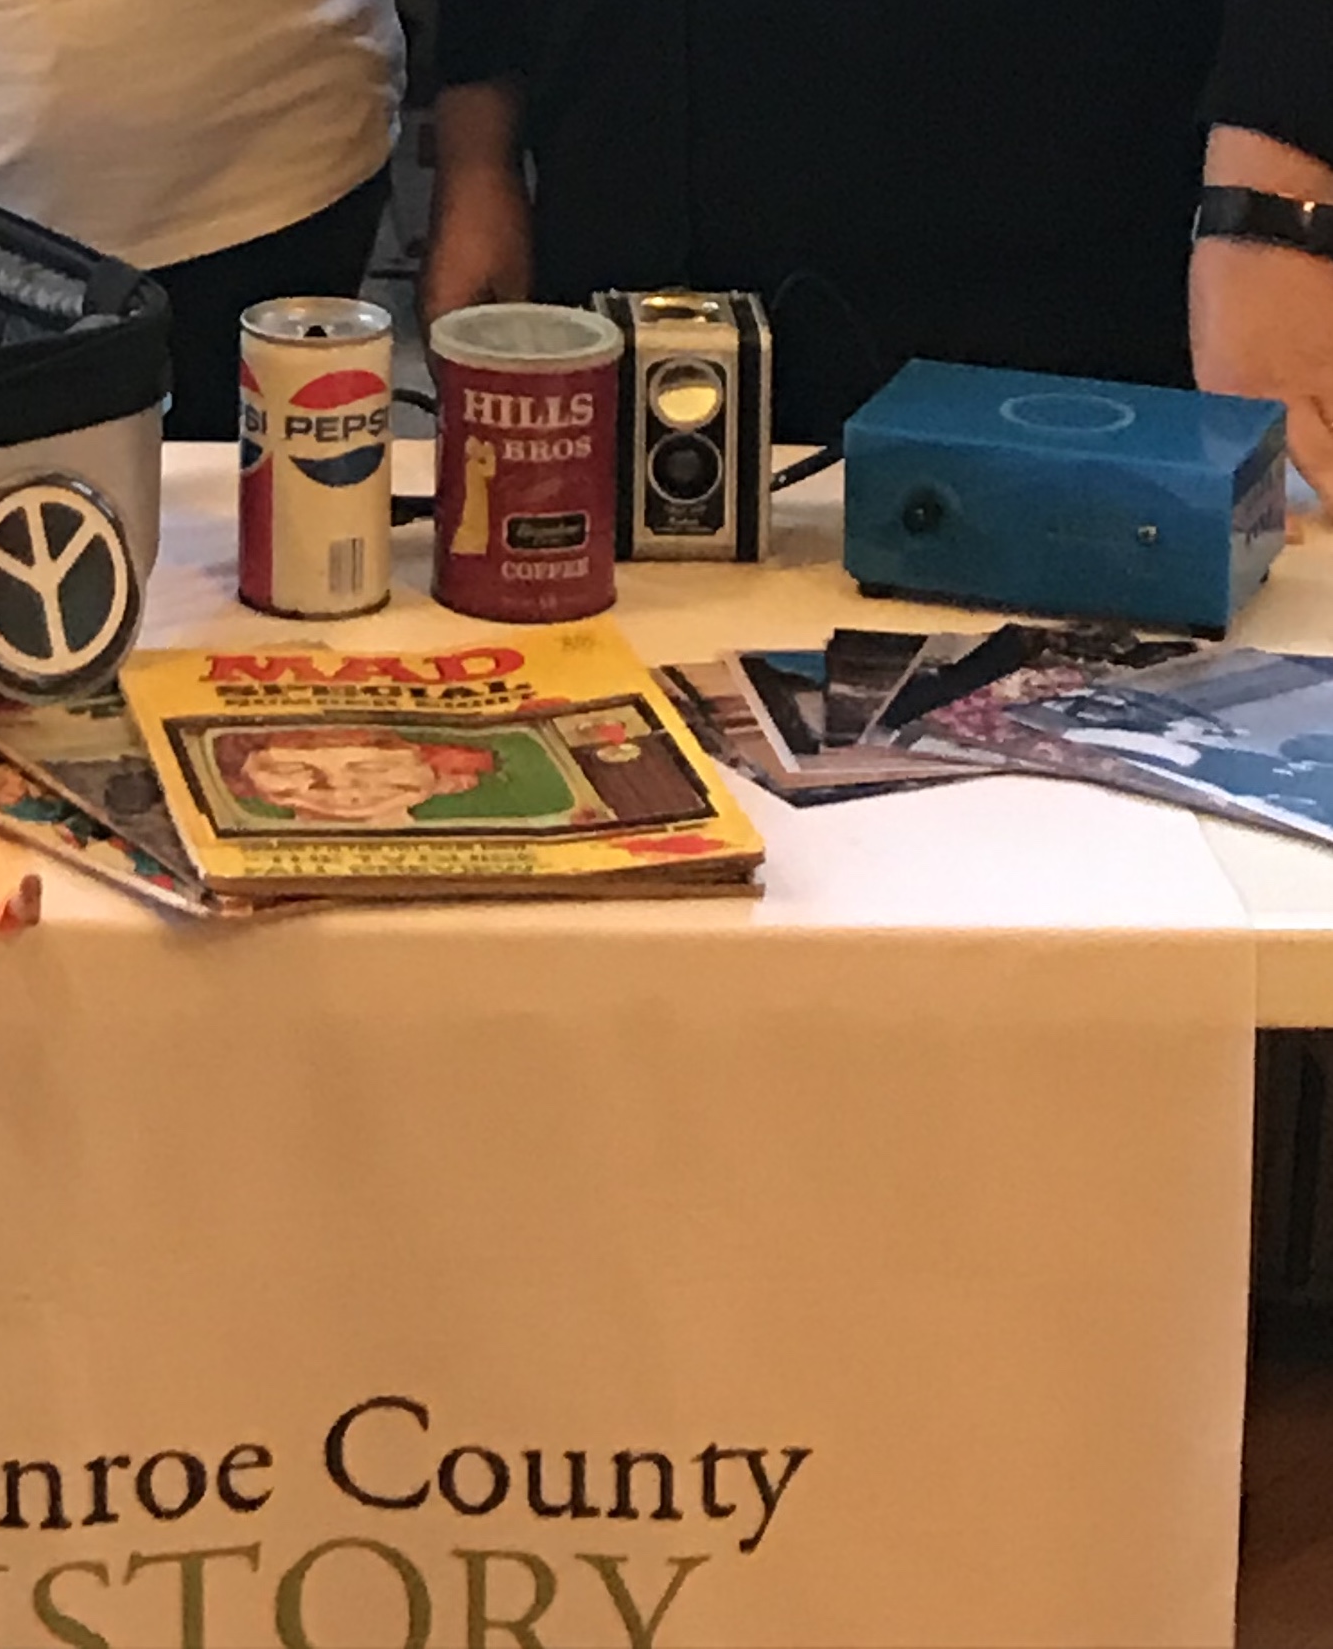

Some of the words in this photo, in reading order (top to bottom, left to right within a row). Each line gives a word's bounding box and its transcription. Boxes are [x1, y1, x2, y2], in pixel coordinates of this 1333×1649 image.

[463, 388, 595, 429] HILLS
[502, 434, 593, 463] BROS
[500, 557, 591, 581] COFFEE
[199, 647, 526, 684] MAD
[323, 1394, 815, 1555] County
